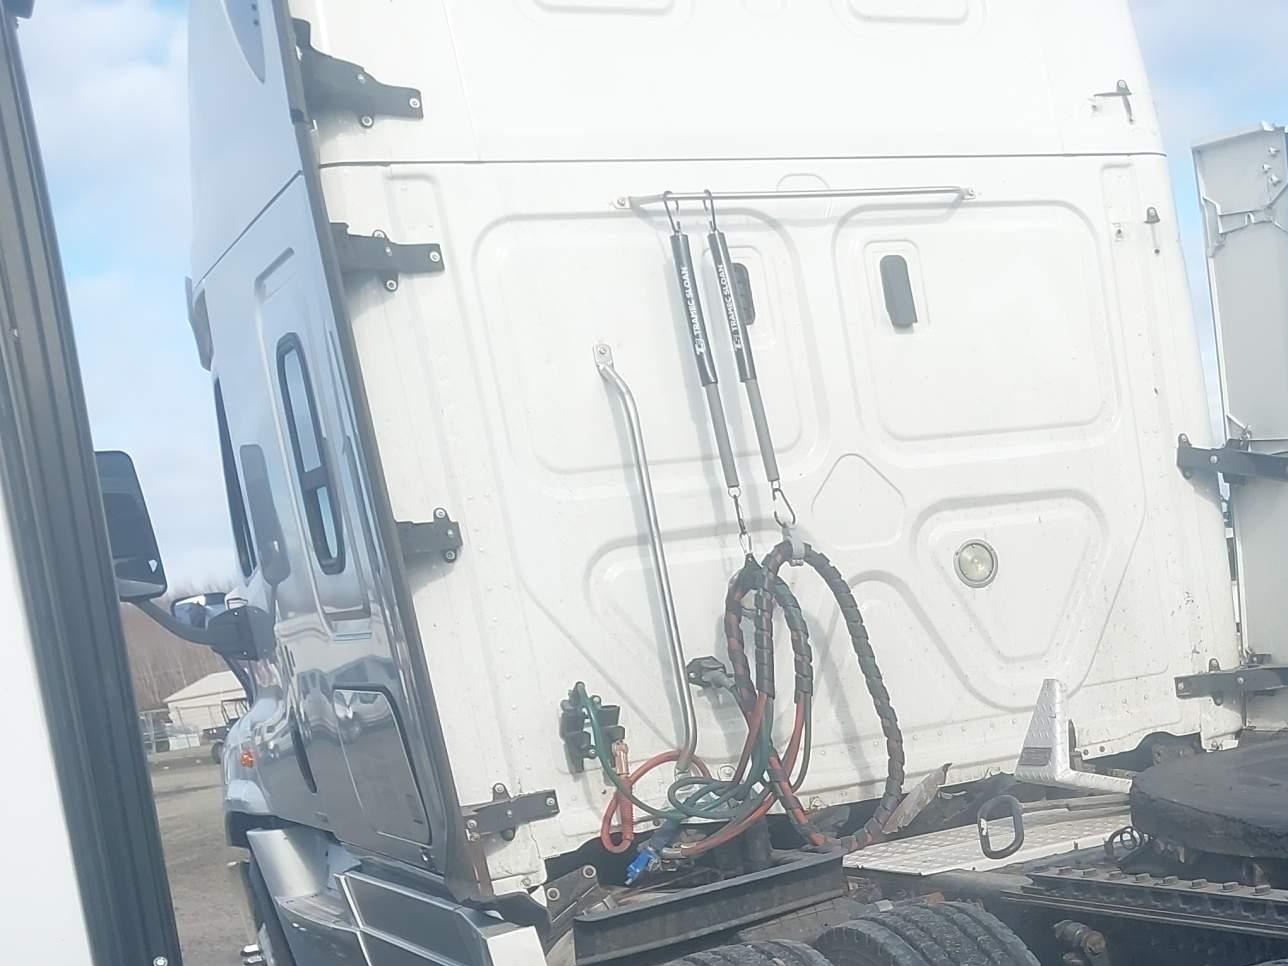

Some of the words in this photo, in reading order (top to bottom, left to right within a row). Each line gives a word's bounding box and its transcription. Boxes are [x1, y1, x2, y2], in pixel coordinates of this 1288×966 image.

[681, 266, 693, 299] SLOAN
[717, 264, 730, 296] SLOAN
[687, 299, 701, 336] TRAMEC
[725, 296, 737, 332] TRAMEC
